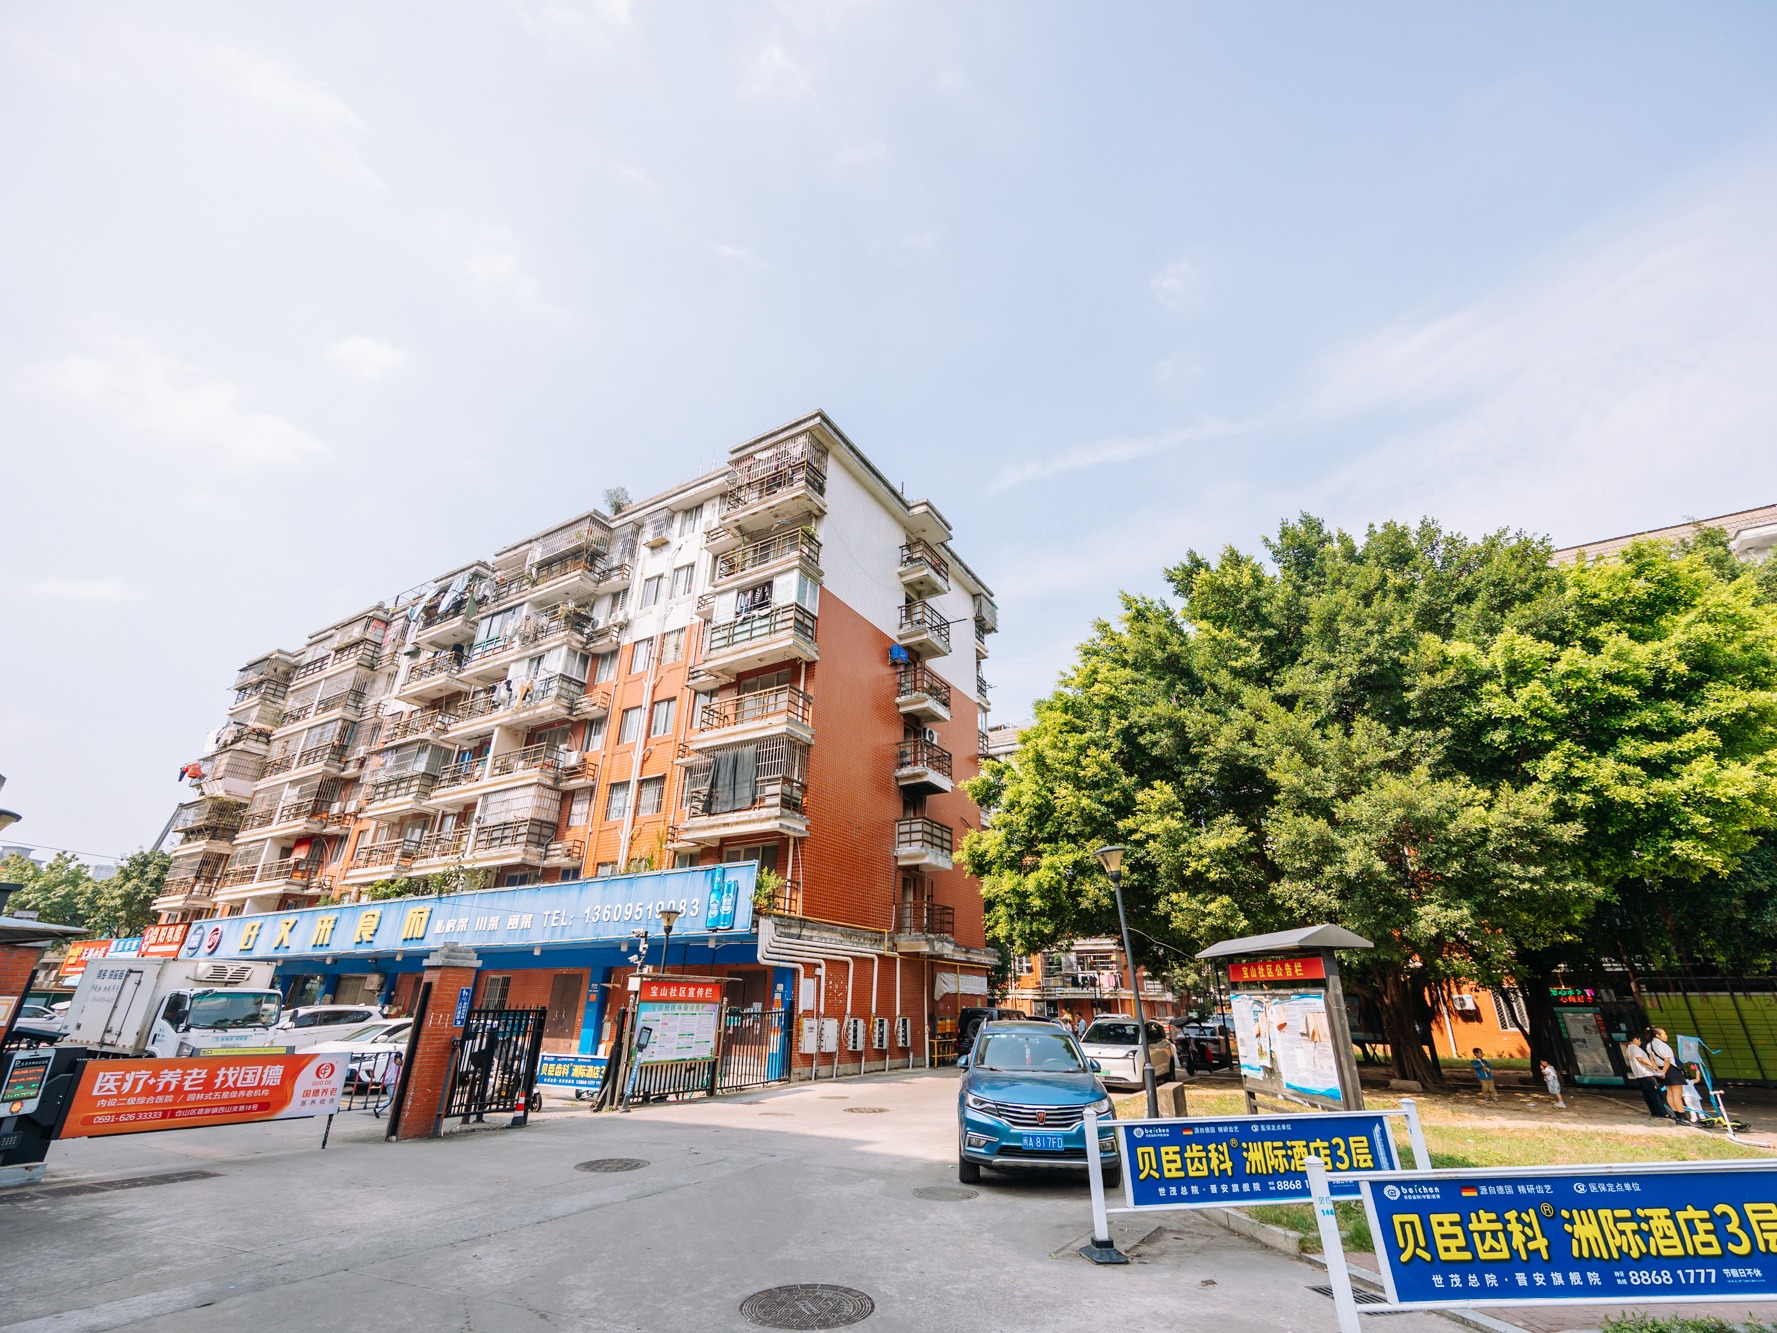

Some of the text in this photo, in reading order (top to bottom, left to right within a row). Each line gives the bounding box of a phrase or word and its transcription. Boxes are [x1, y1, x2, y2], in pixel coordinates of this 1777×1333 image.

[239, 906, 433, 951] 好又来食府
[475, 916, 501, 931] 川菜
[543, 909, 575, 927] TEL:
[1242, 962, 1304, 979] 宝山社区公告栏
[649, 986, 713, 998] 宝山社区宣传栏
[571, 1064, 606, 1079] 洲际酒店3
[92, 1065, 285, 1096] 医疗+养老 找国德
[97, 1089, 269, 1108] 内设二级综合医院 园林式五星级养老机构
[302, 1087, 338, 1098] 国德养老
[300, 1097, 335, 1106] 医养结合
[93, 1113, 135, 1124] 0591-626
[138, 1111, 162, 1120] 33333
[1242, 1136, 1374, 1175] 洲际酒店3层
[1276, 1179, 1302, 1190] 8868
[1400, 1185, 1440, 1194] beichen
[1479, 1184, 1553, 1196] 源自德国 精研齿艺
[1587, 1181, 1642, 1193] 医保定点单位
[1562, 1202, 1777, 1261] 洲际酒店3层
[1629, 1268, 1717, 1285] 8868 1777
[1722, 1267, 1763, 1278] 节假日不休
